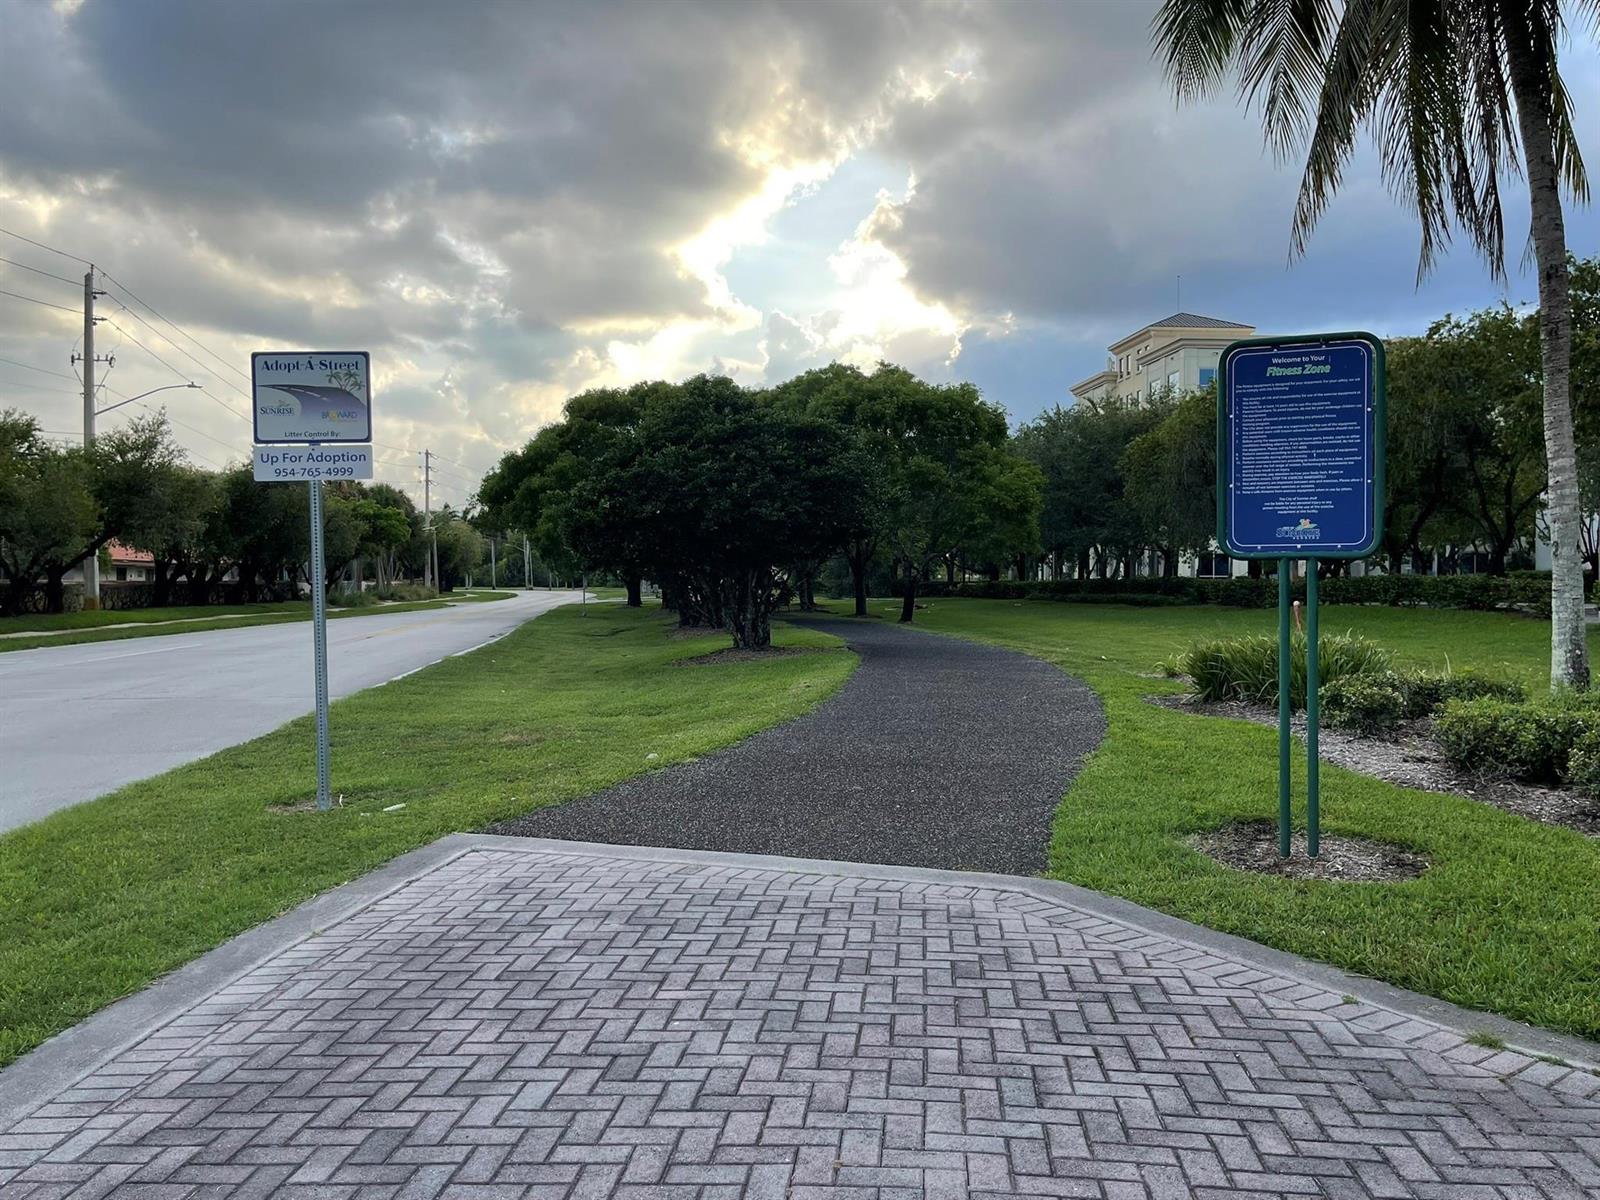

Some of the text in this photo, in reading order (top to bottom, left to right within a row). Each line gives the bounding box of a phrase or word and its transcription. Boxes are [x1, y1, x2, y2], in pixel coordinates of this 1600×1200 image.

[1271, 356, 1302, 364] Welcome
[261, 359, 360, 373] Adopt-A-Street
[1266, 364, 1331, 376] Fitness Zone
[260, 406, 295, 415] SUNRISE
[260, 452, 367, 465] Up For Adoption
[274, 467, 354, 477] 954-765-4999
